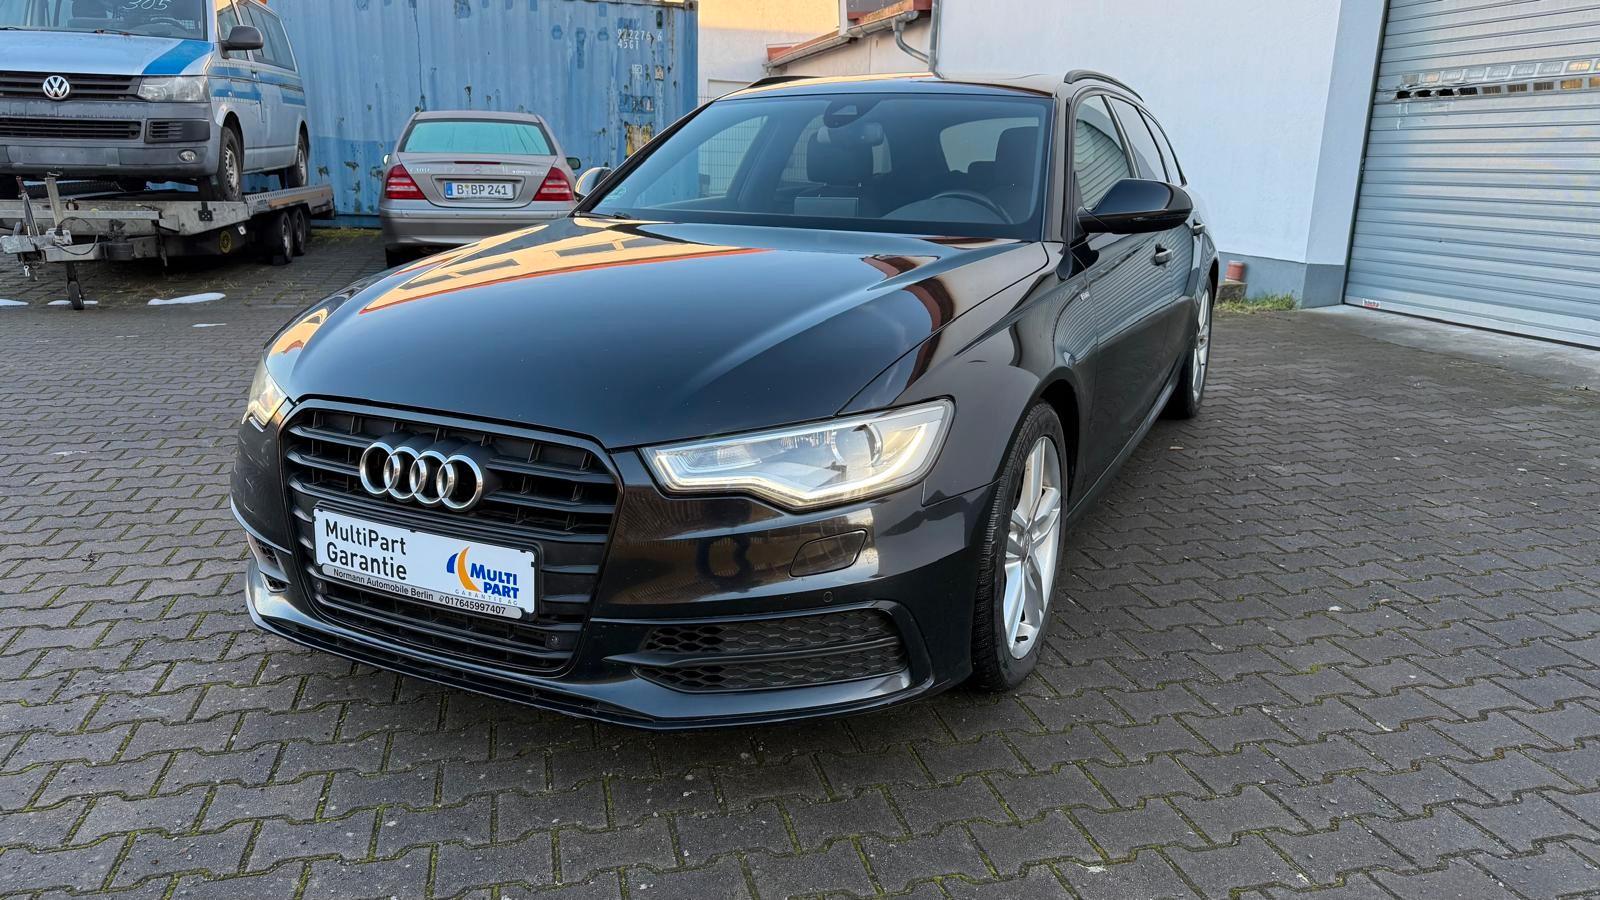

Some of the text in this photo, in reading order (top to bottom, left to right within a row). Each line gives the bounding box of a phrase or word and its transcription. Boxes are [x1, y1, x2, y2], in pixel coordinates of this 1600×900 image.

[456, 184, 508, 195] B BP 241
[325, 518, 406, 555] MultiPart
[326, 541, 407, 580] Garantie
[470, 562, 517, 586] MULTI
[333, 568, 506, 615] Normann Automobile Berlin 017645997407
[483, 581, 519, 599] PART
